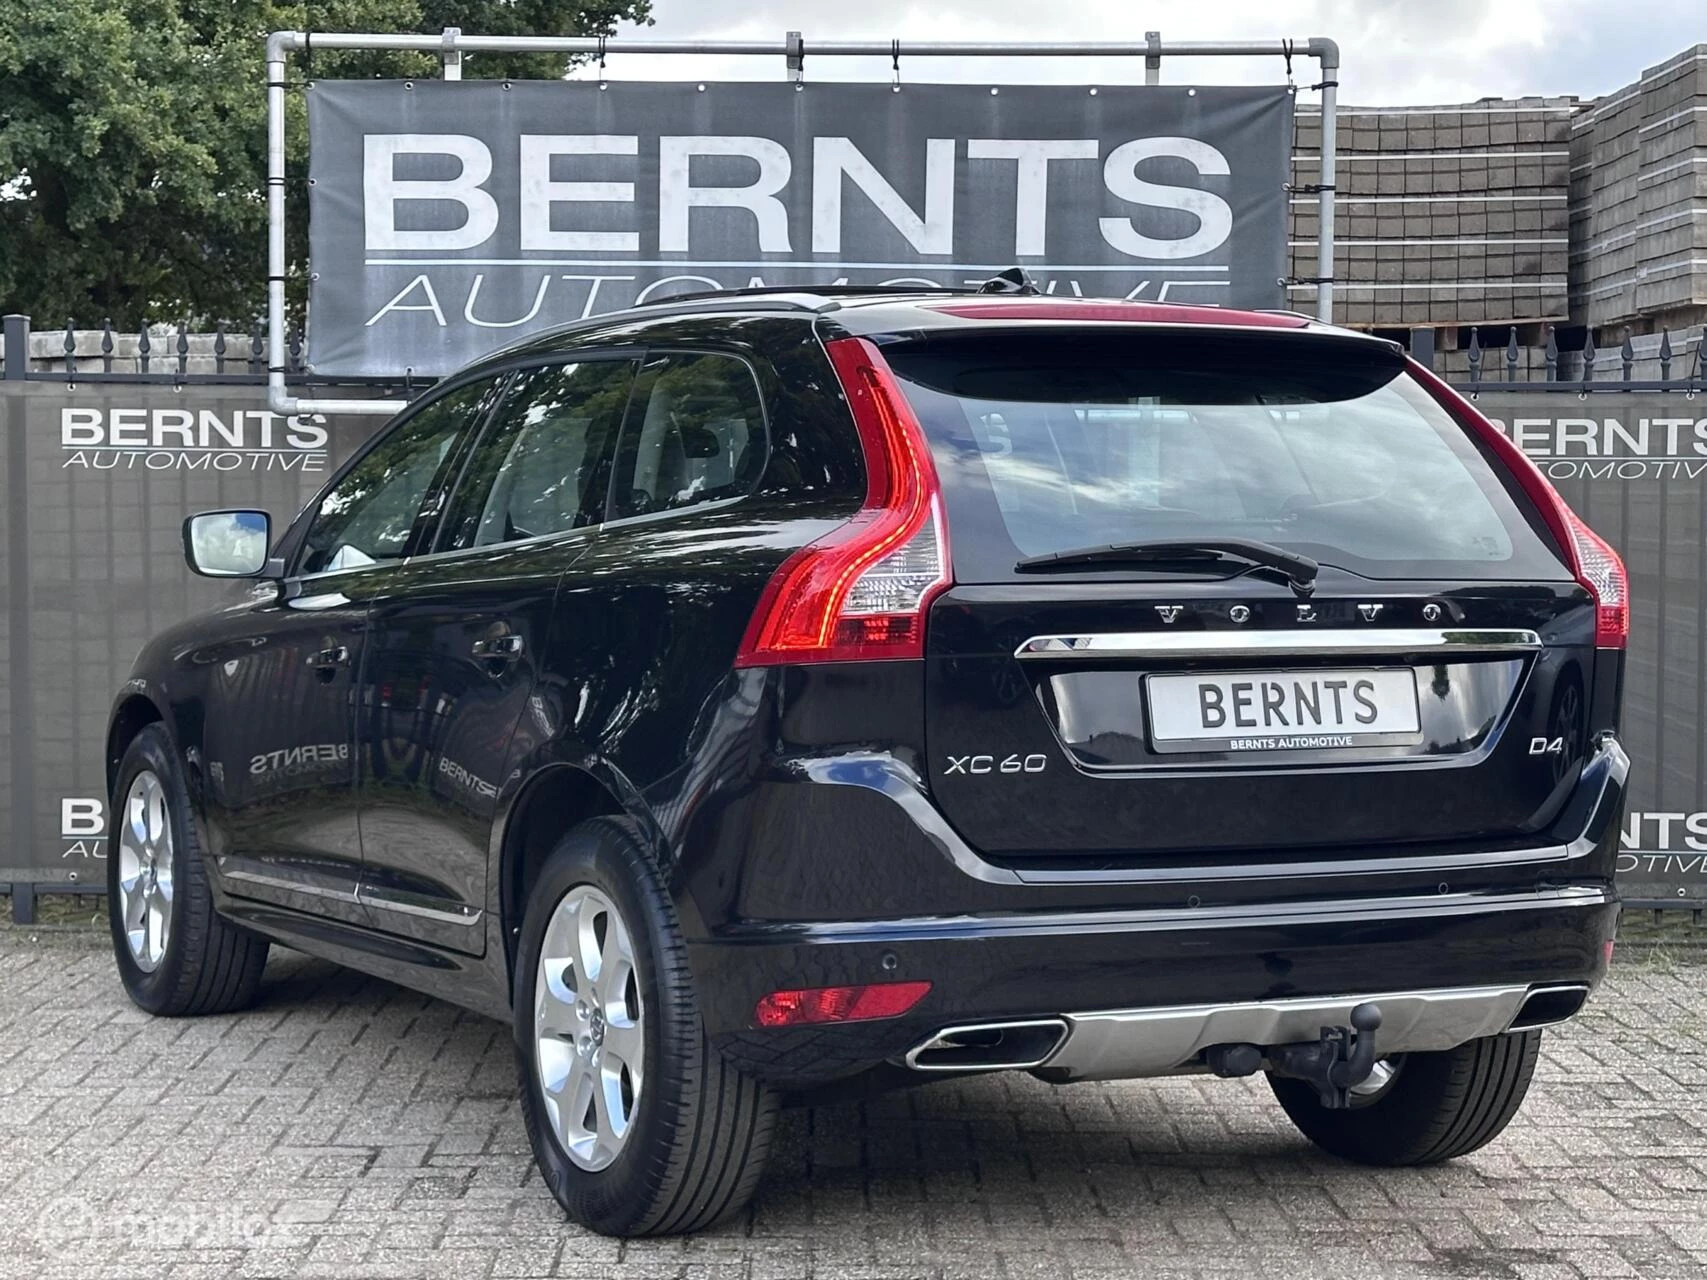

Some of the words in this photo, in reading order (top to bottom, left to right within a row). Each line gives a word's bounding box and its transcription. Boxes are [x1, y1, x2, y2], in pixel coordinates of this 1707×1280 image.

[362, 134, 1232, 259] BERNTS
[61, 407, 328, 449] BERNTS
[1489, 418, 1707, 456] ERNT
[62, 450, 328, 472] AUTOMOTIVE
[1154, 603, 1442, 624] VOLVO
[1198, 680, 1378, 729] BERNTS
[1230, 737, 1275, 750] BERNTS
[1278, 736, 1353, 749] AUTOMOTIVE
[1529, 737, 1563, 754] D4
